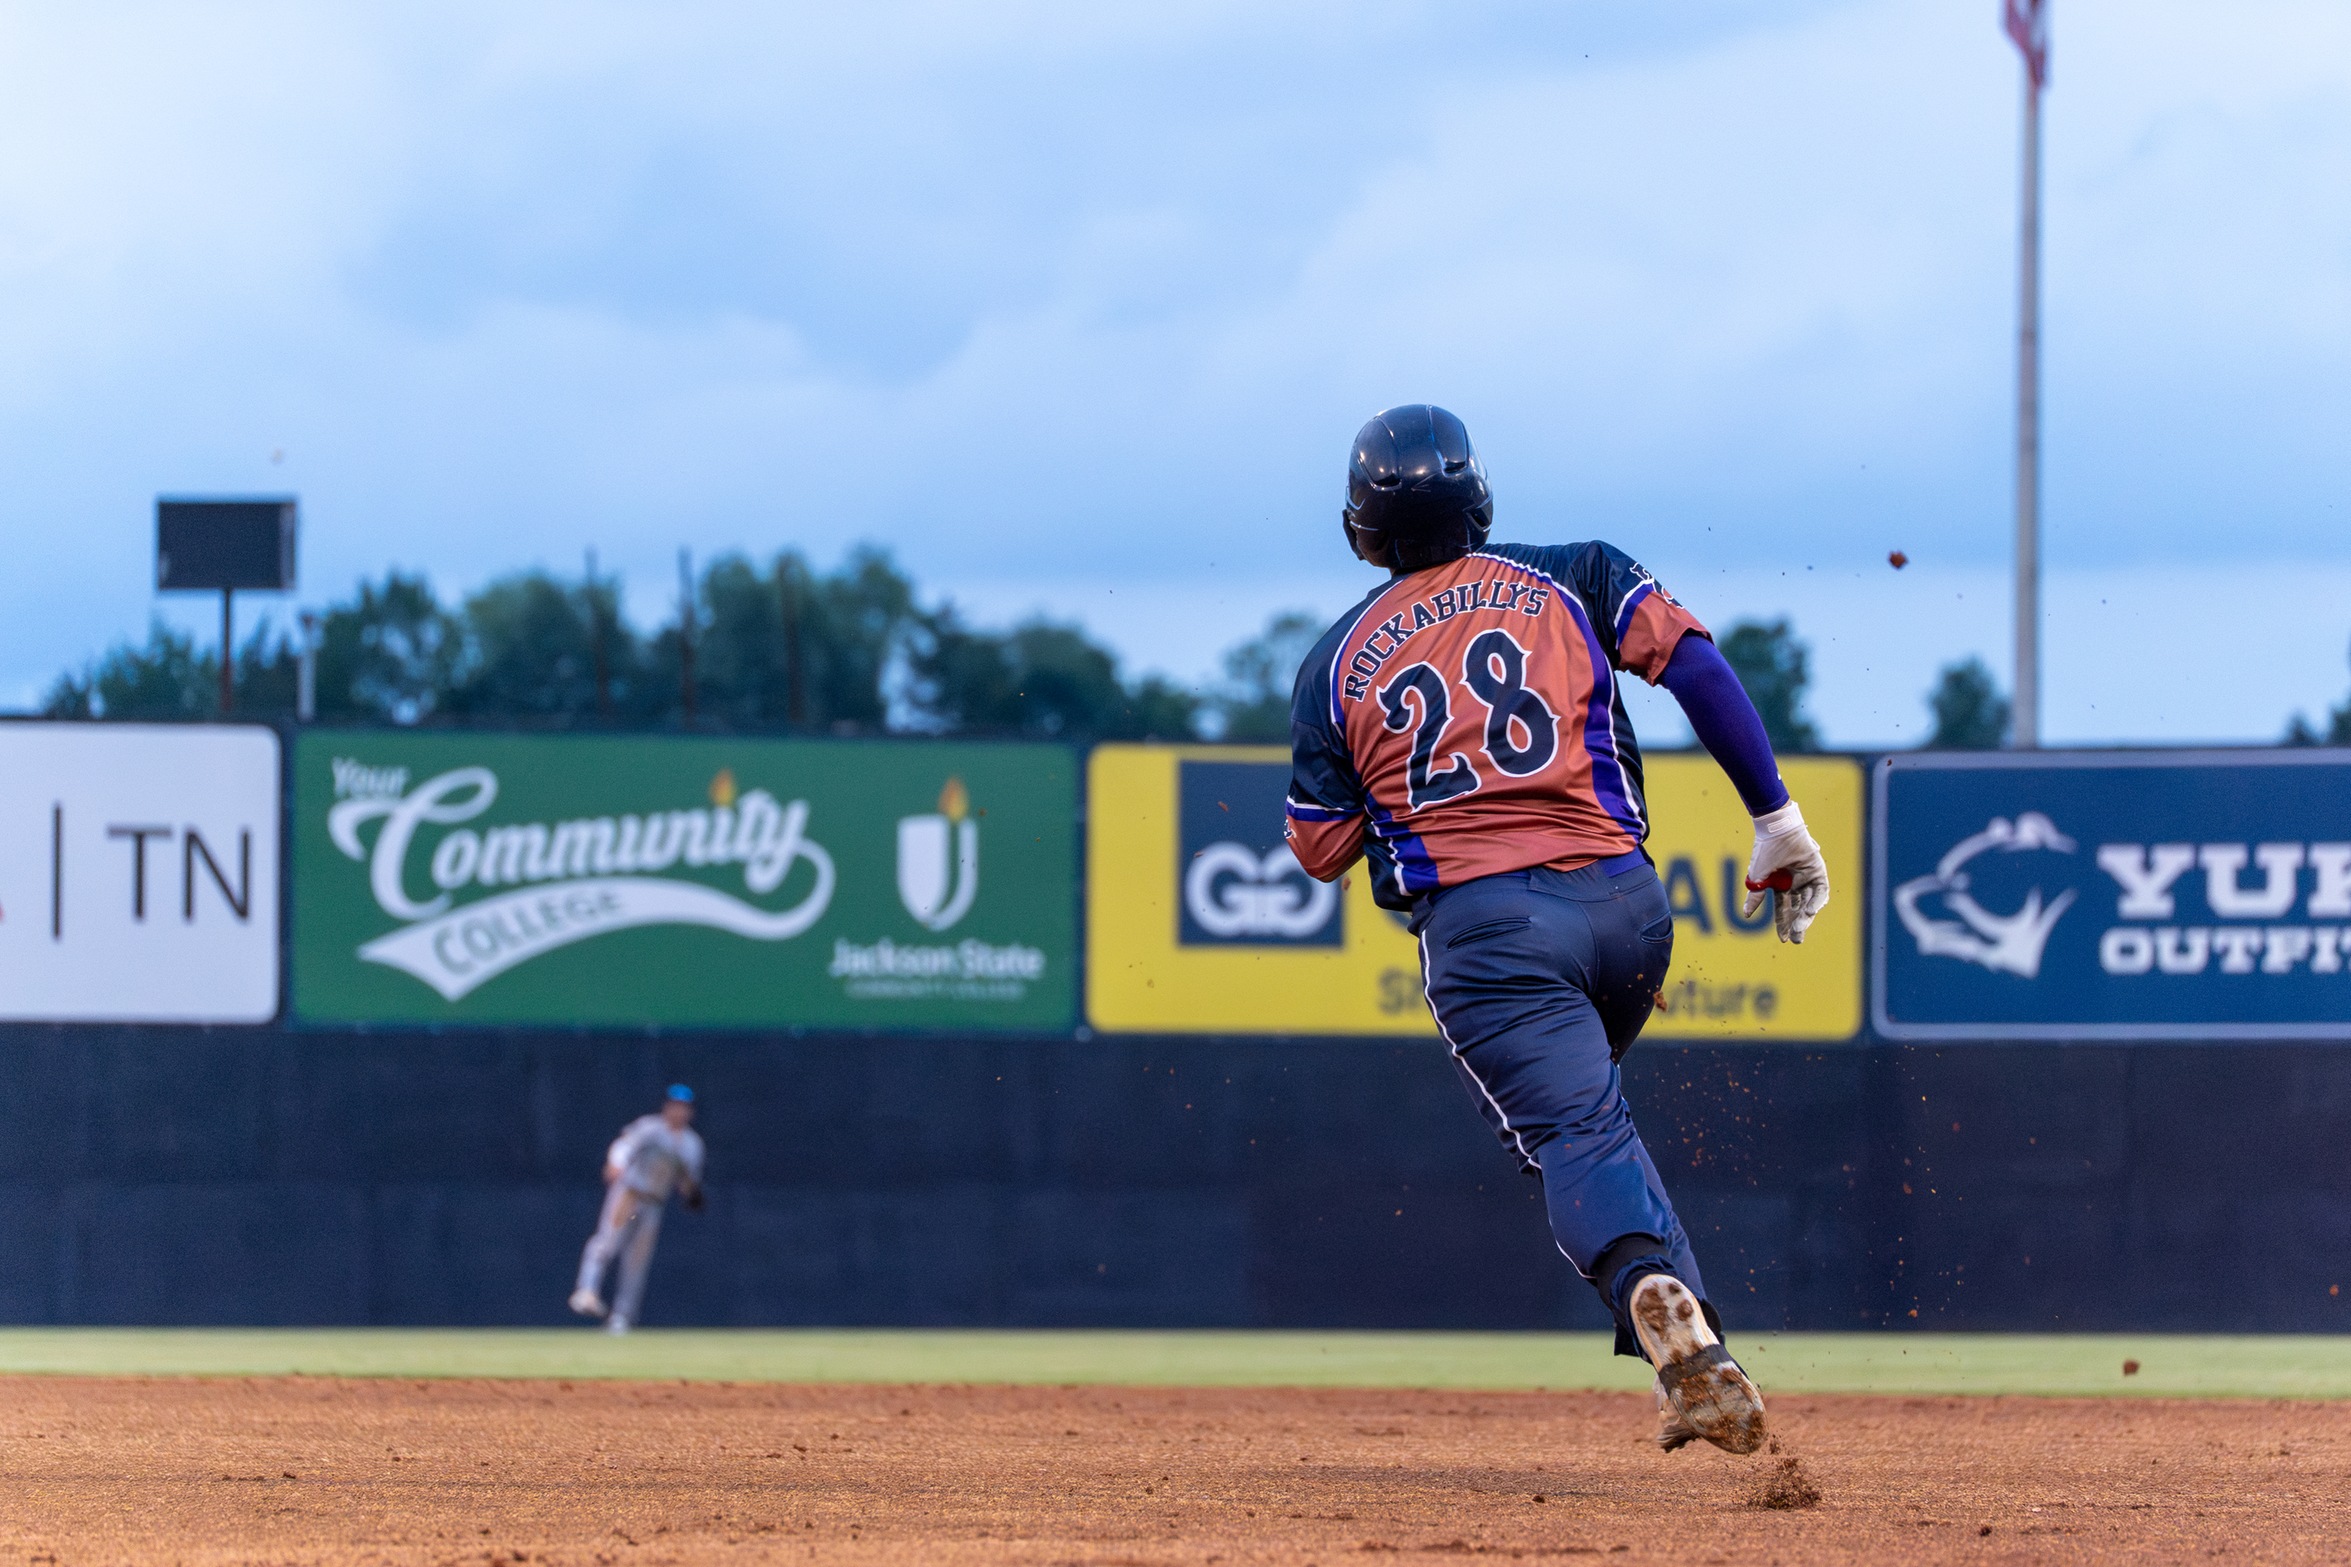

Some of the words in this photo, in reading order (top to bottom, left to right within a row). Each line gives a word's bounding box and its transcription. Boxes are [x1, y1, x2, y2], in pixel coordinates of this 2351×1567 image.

[1343, 579, 1550, 702] ROCKABILLYS
[1376, 628, 1561, 813] 28
[107, 824, 251, 923] TN
[327, 766, 812, 921] Community
[2100, 926, 2351, 975] OUTFI
